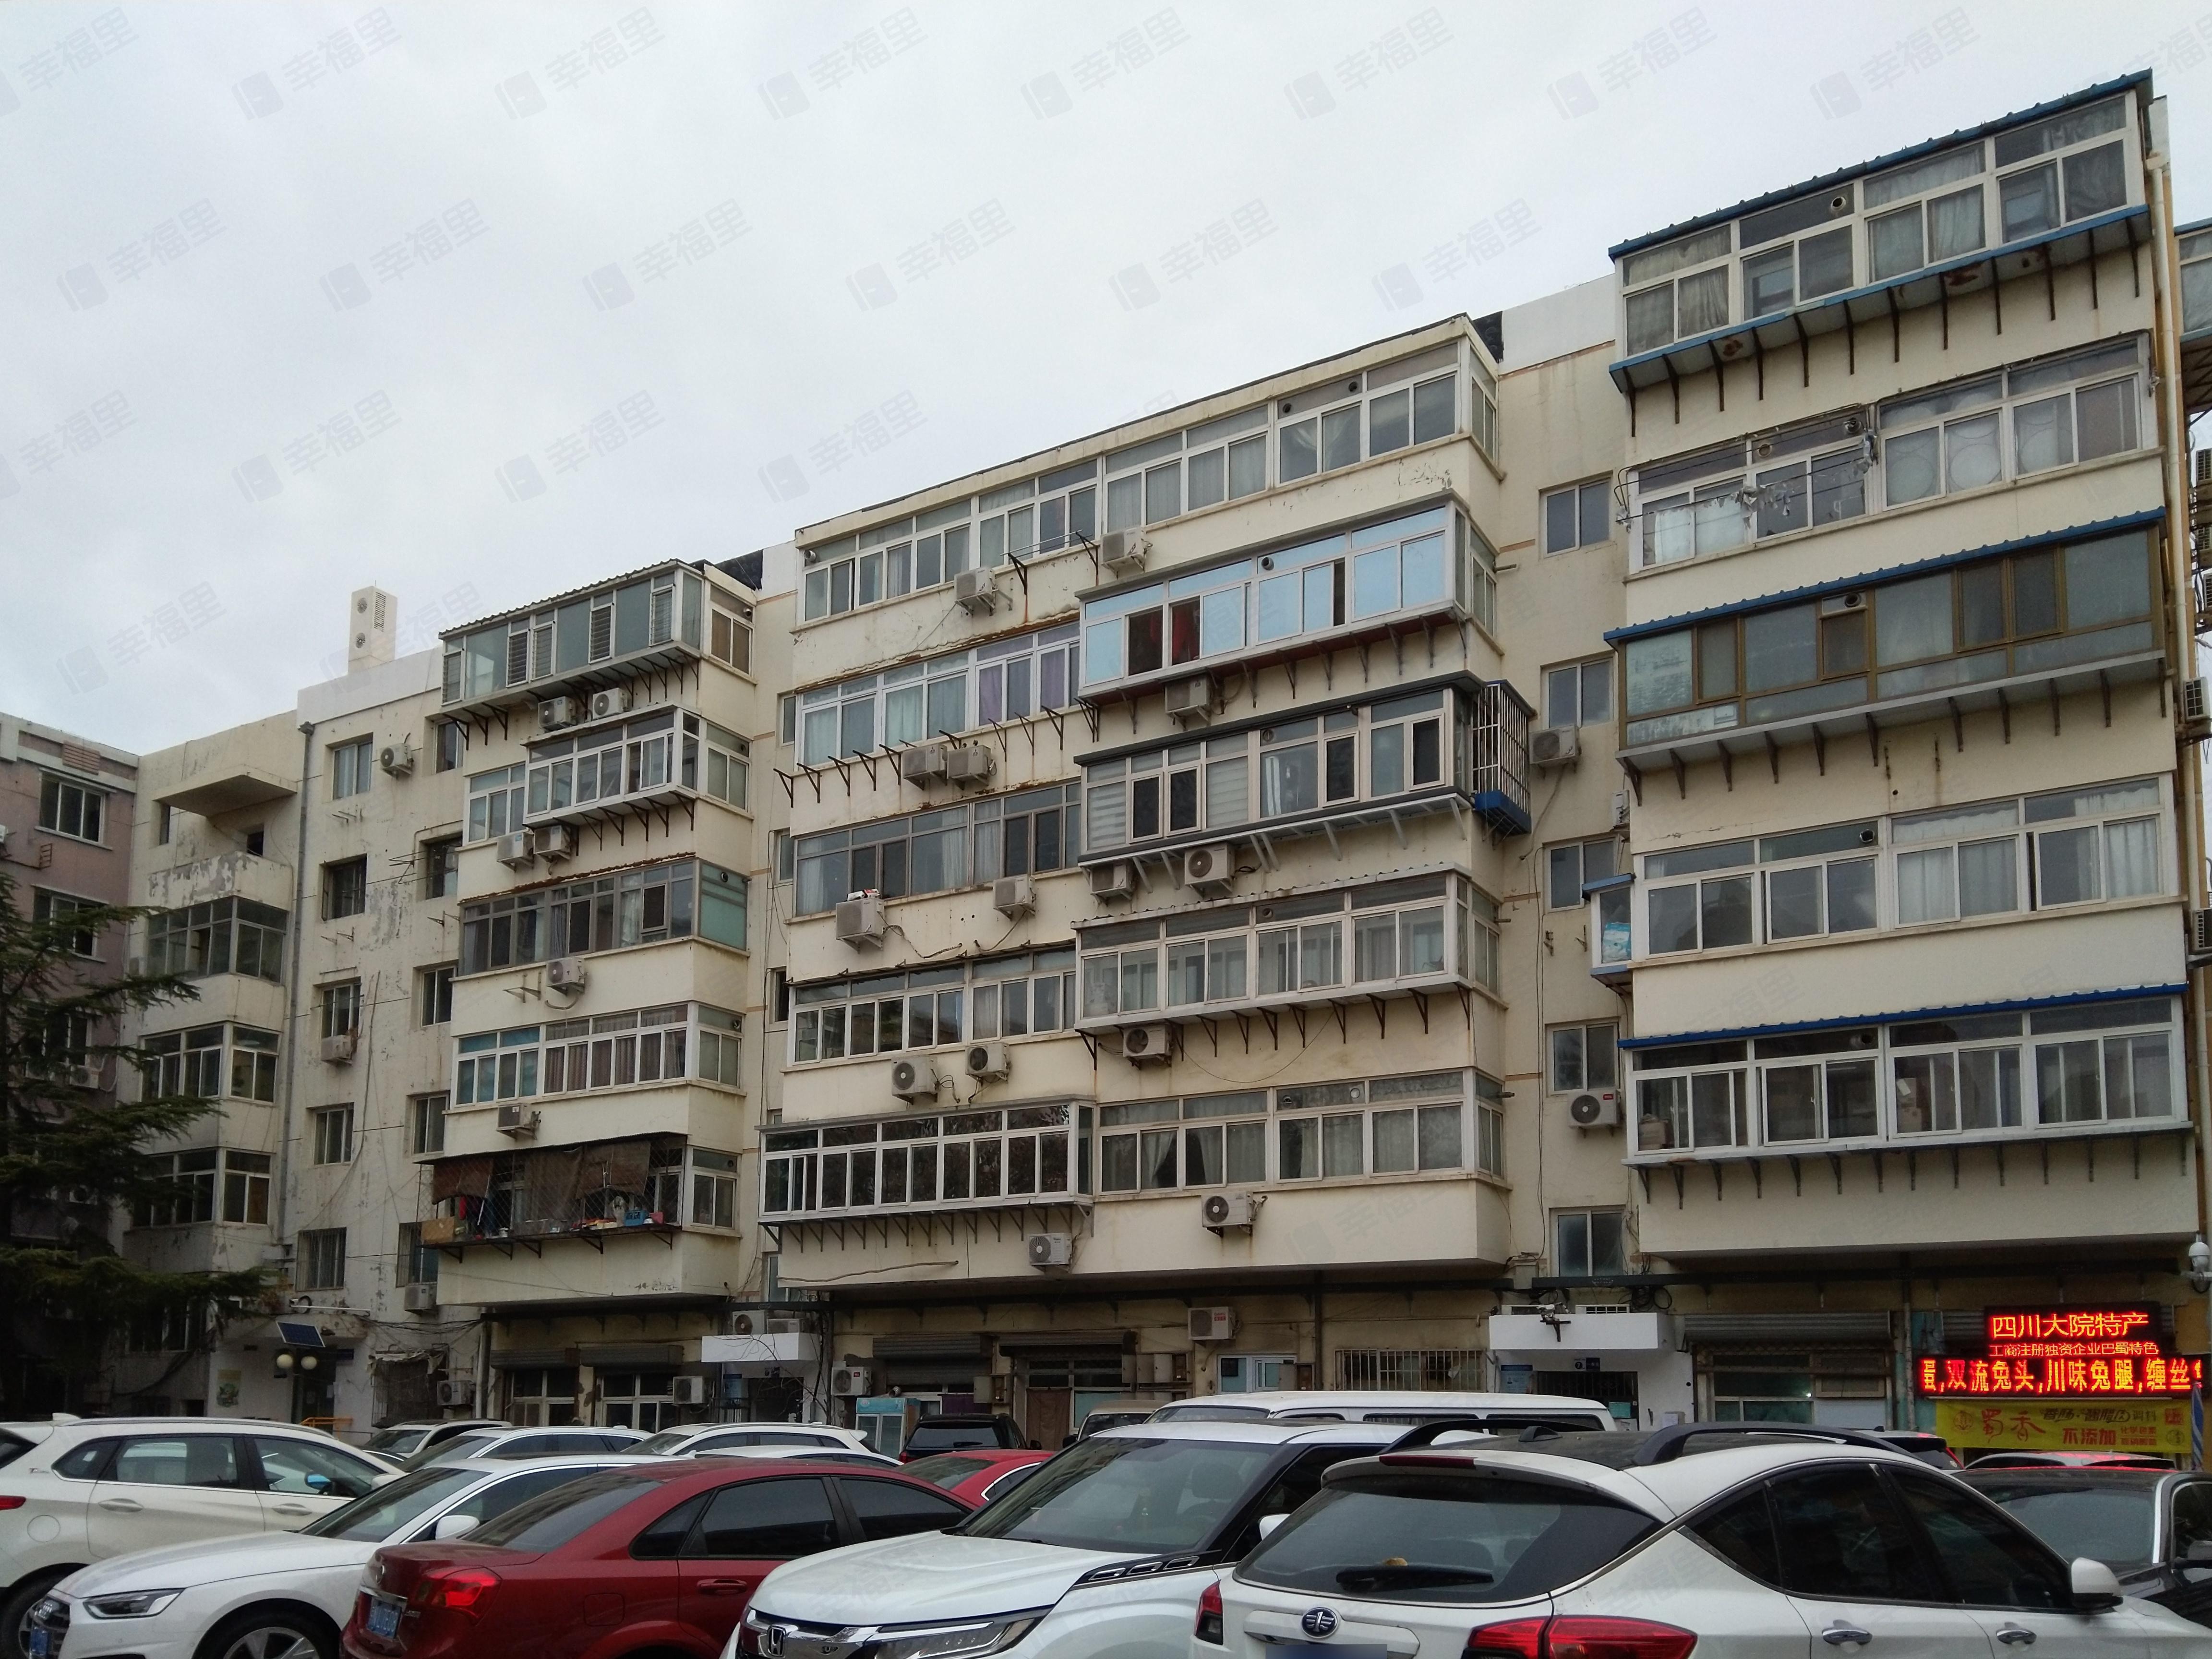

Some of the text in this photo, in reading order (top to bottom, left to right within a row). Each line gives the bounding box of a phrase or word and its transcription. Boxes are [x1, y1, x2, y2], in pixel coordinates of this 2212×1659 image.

[1993, 1312, 2149, 1338] 四川大院特产
[1989, 1342, 2159, 1357] 工商注册独资企业巴蜀特色
[1982, 1408, 2046, 1443] 蜀香
[2063, 1428, 2116, 1445] 不添加
